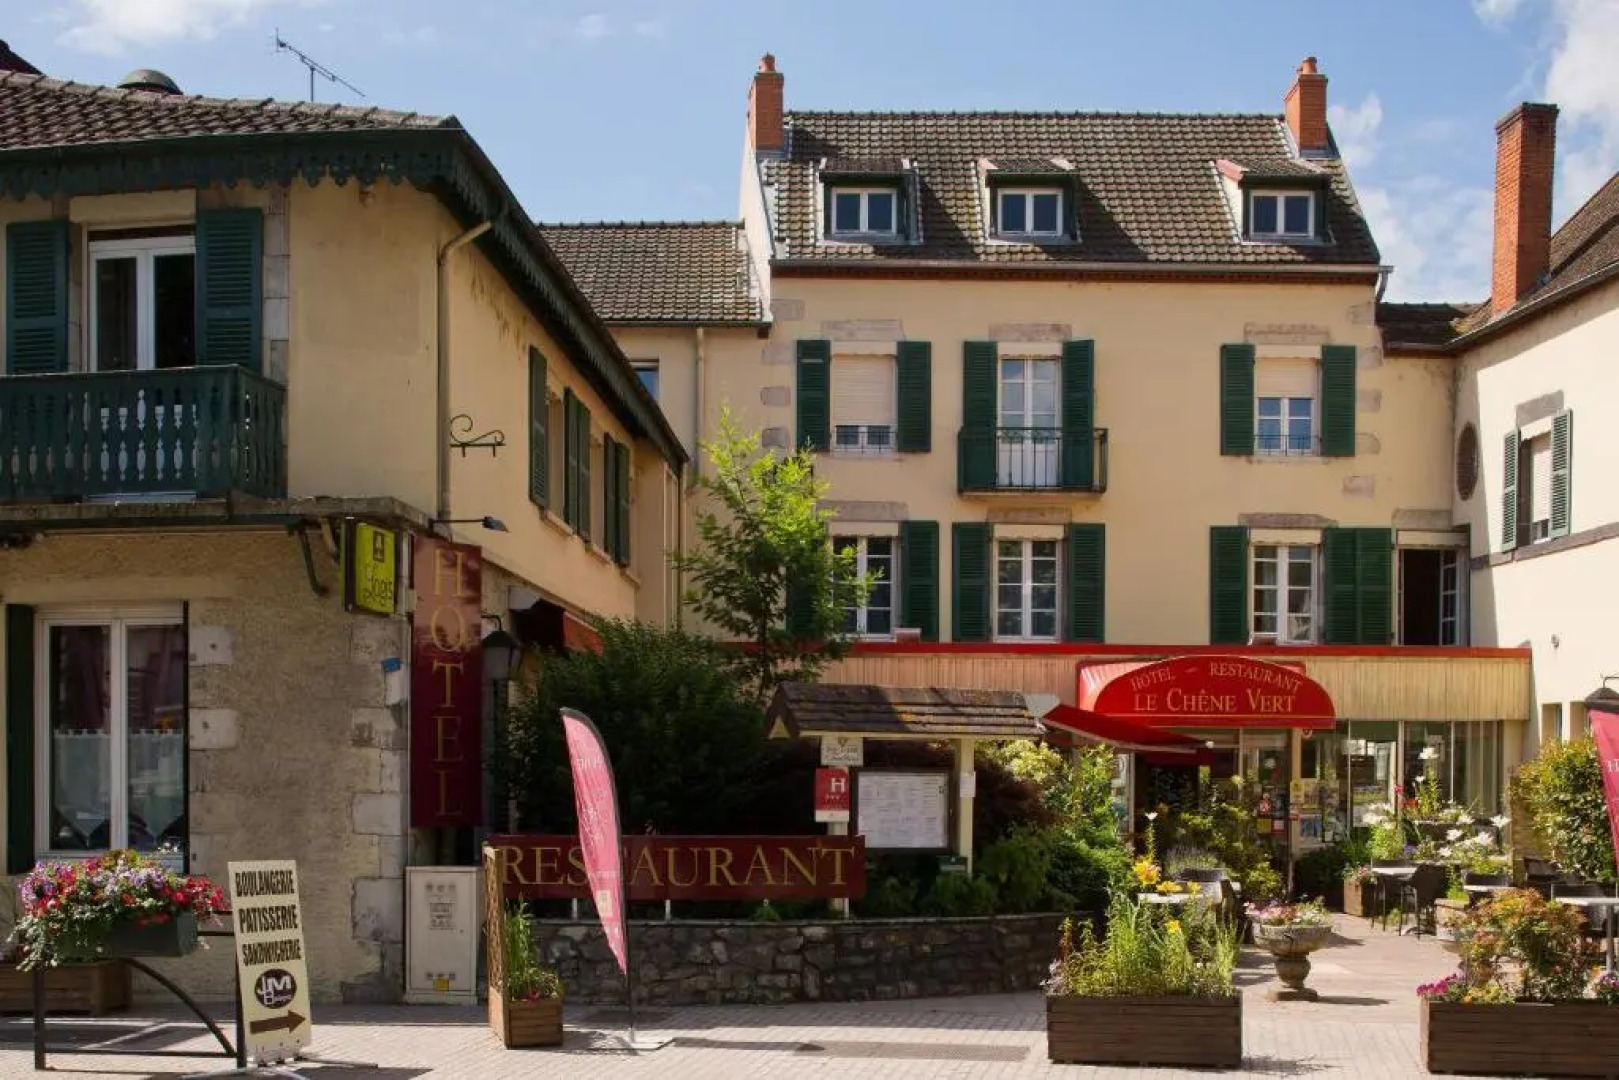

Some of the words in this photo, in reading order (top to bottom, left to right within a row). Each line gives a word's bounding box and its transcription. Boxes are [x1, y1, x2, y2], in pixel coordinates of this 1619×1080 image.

[431, 549, 466, 816] HOTEL
[1210, 663, 1302, 692] RESTAURANT
[1134, 694, 1158, 711] LE
[1246, 689, 1297, 713] VERT
[831, 777, 845, 793] H
[500, 845, 855, 887] RESAURANT
[235, 870, 294, 897] BOULANGERIE
[239, 904, 298, 933] PATISSERIE
